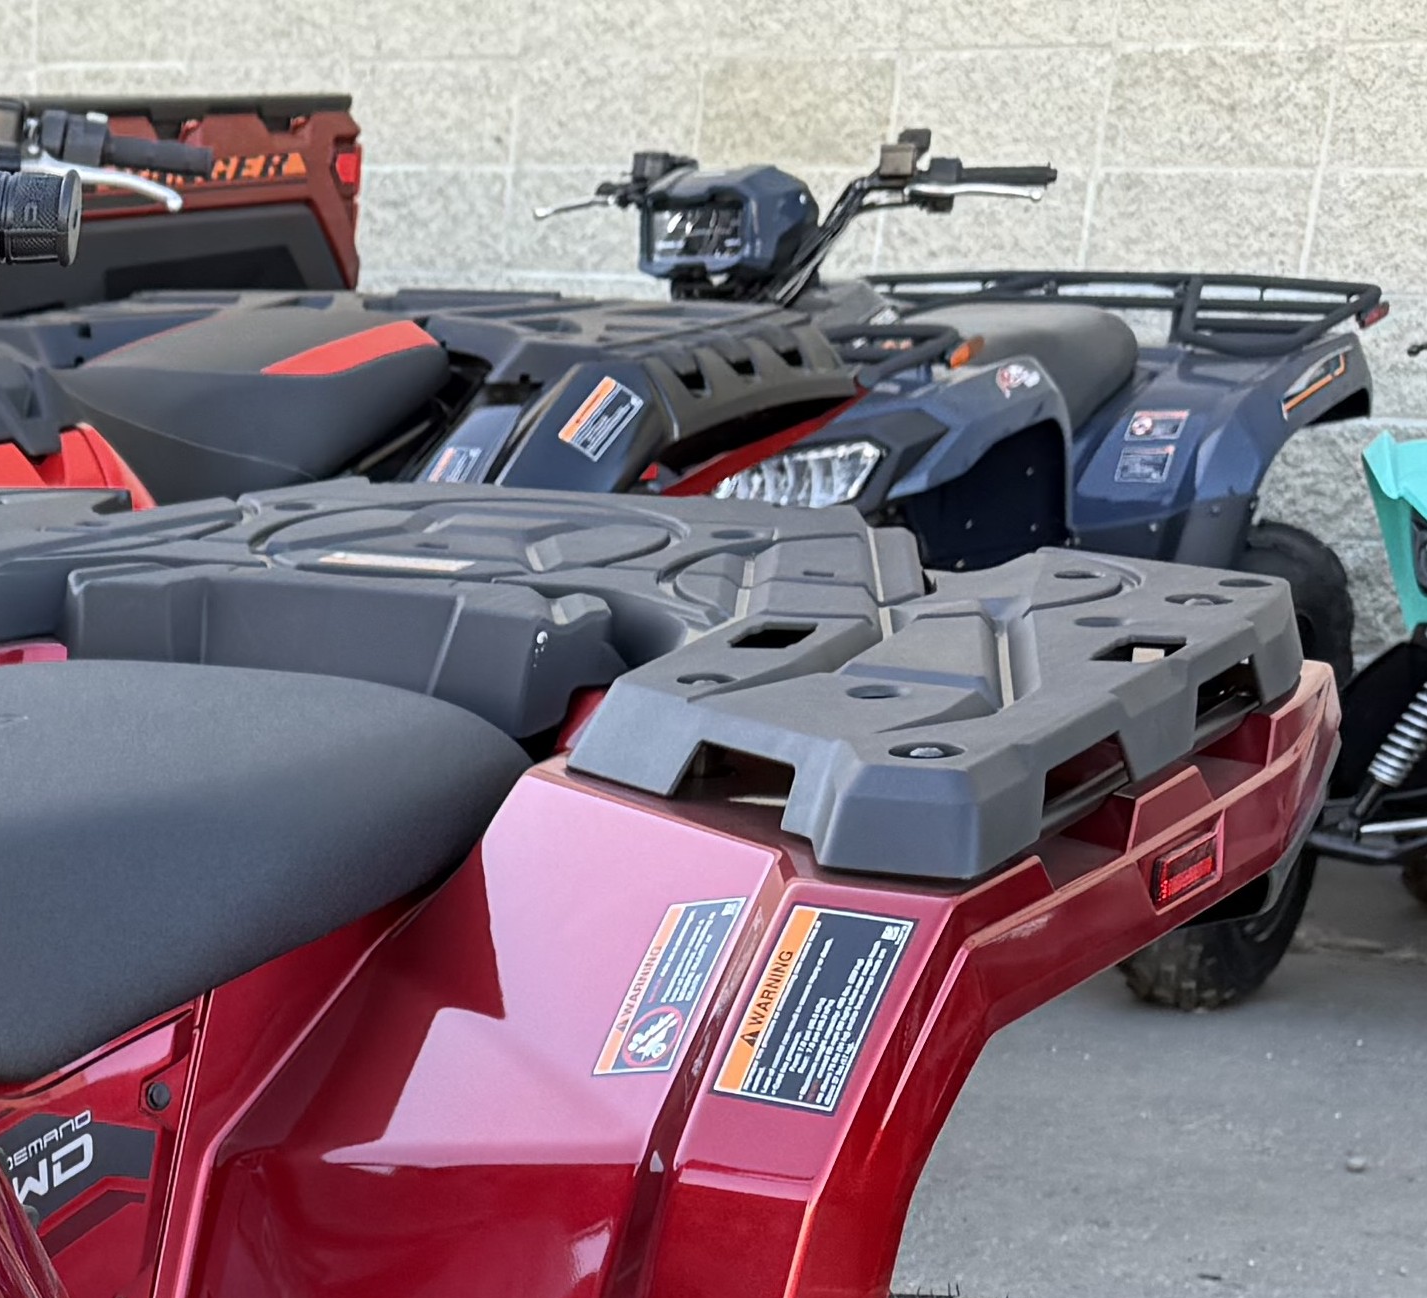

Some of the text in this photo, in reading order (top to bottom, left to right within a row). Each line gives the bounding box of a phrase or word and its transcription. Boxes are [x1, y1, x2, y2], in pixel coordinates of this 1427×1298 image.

[621, 945, 662, 1015] WARNING
[748, 949, 794, 1026] WARNING
[12, 1133, 94, 1203] WD
